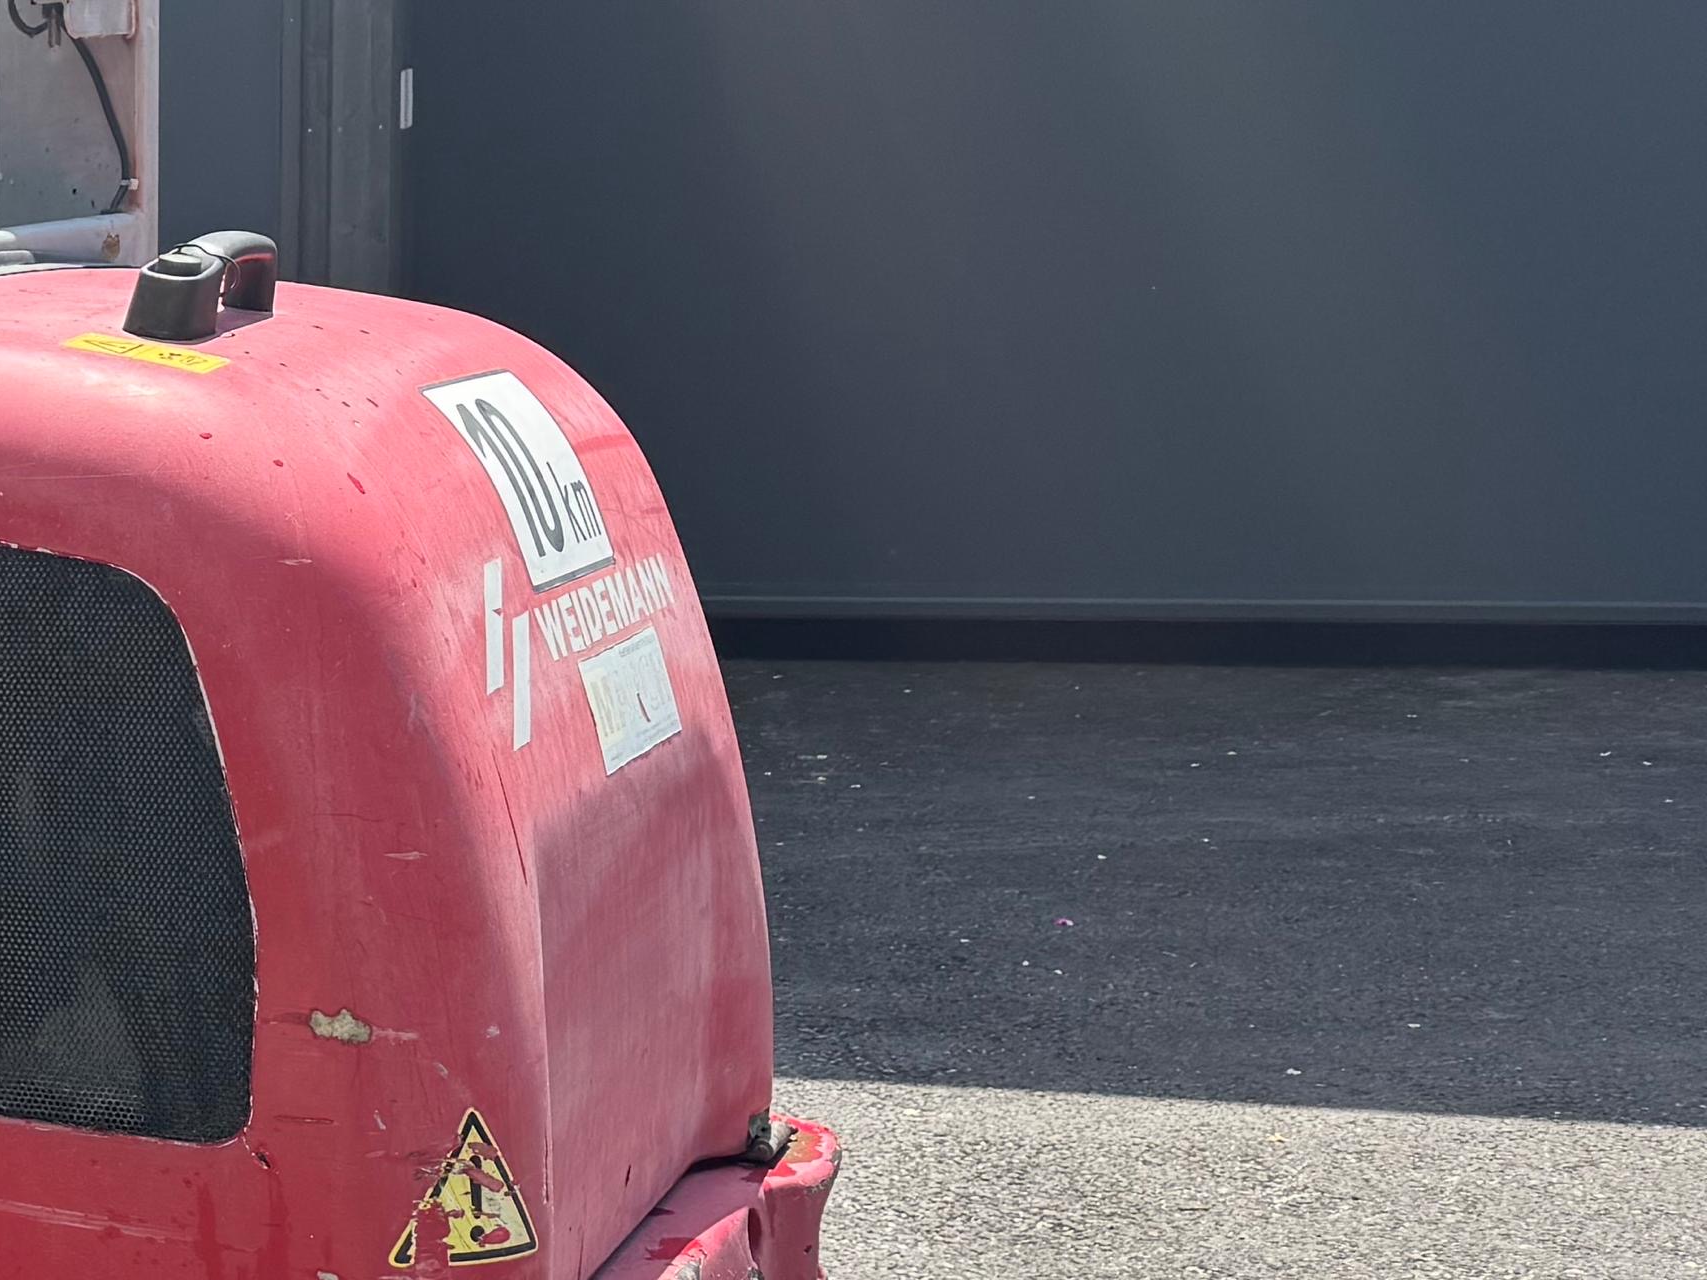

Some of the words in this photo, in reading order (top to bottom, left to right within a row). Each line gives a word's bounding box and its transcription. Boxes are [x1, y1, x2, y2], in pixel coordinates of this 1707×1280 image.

[455, 397, 566, 558] 10
[545, 460, 601, 545] km
[533, 552, 677, 662] WEIDEMANN
